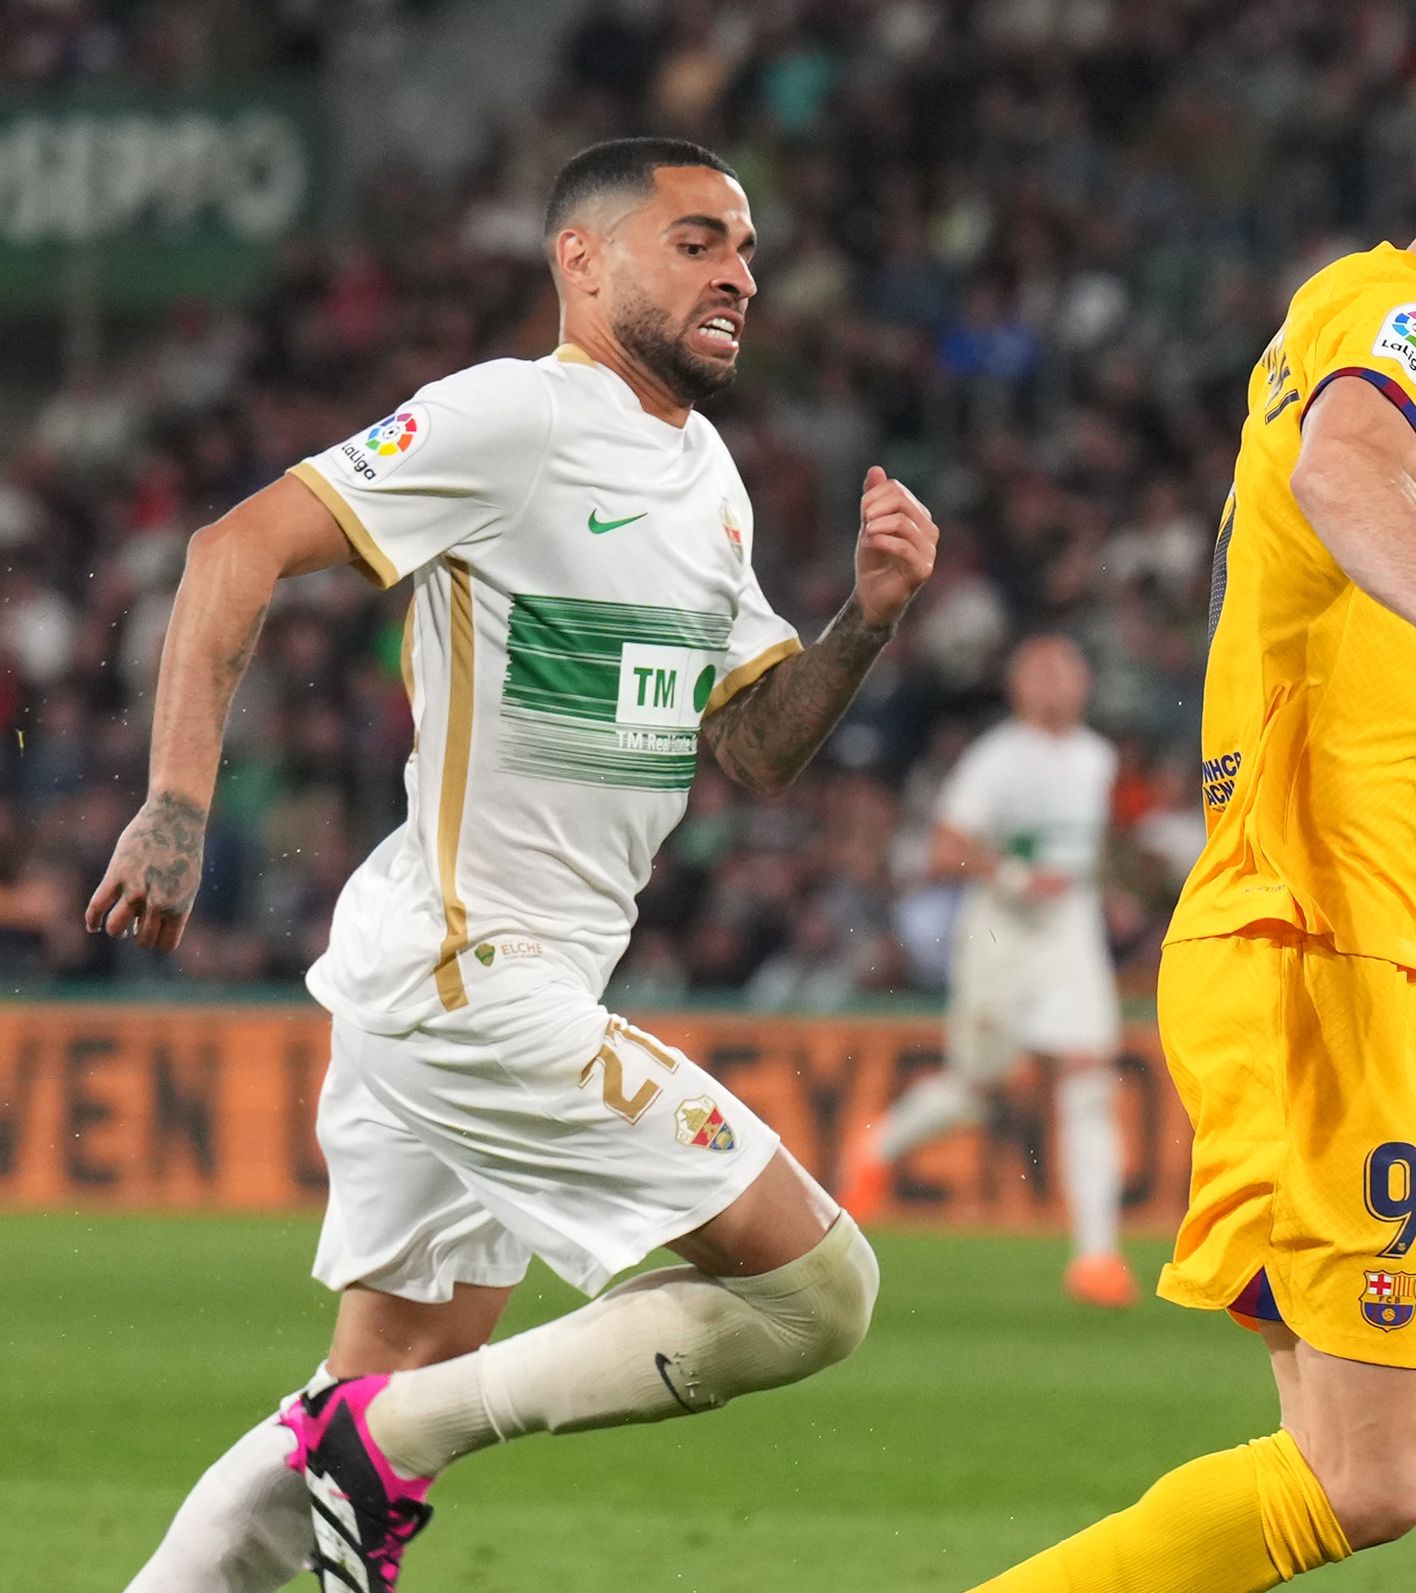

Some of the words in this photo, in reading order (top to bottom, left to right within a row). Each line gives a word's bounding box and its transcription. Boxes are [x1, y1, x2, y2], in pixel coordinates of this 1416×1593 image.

[341, 442, 377, 481] LaLiga
[633, 667, 677, 709] TM
[501, 942, 543, 955] ELCHE
